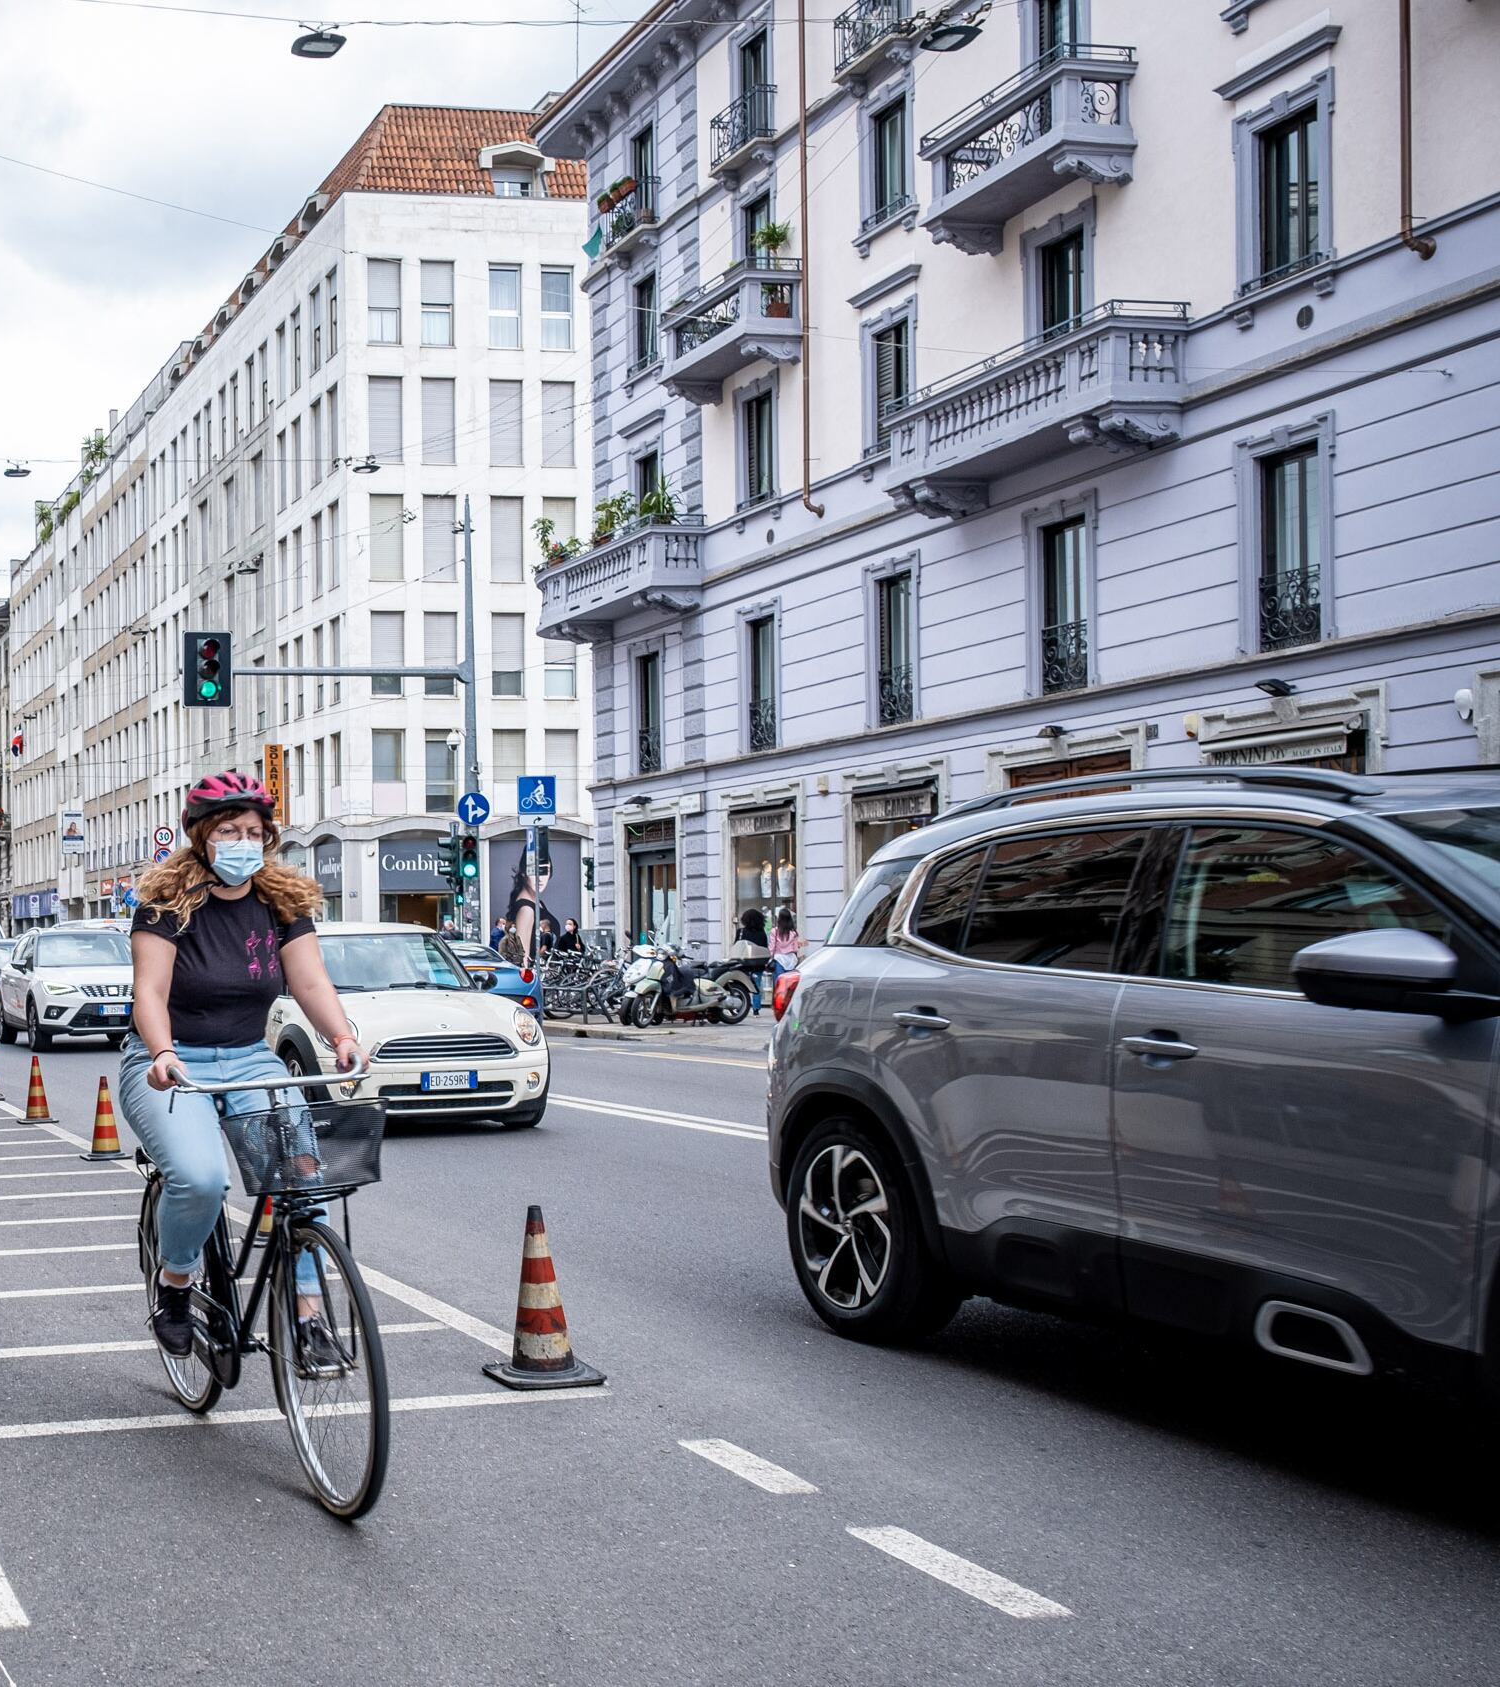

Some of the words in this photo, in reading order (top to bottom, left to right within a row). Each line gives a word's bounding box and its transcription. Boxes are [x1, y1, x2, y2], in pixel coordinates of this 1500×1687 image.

[1214, 746, 1267, 766] BERNINI
[1292, 749, 1311, 757] MADE
[1313, 748, 1322, 756] IN
[1323, 744, 1343, 755] ITALY
[158, 832, 169, 841] 30
[382, 853, 450, 876] Conbìp
